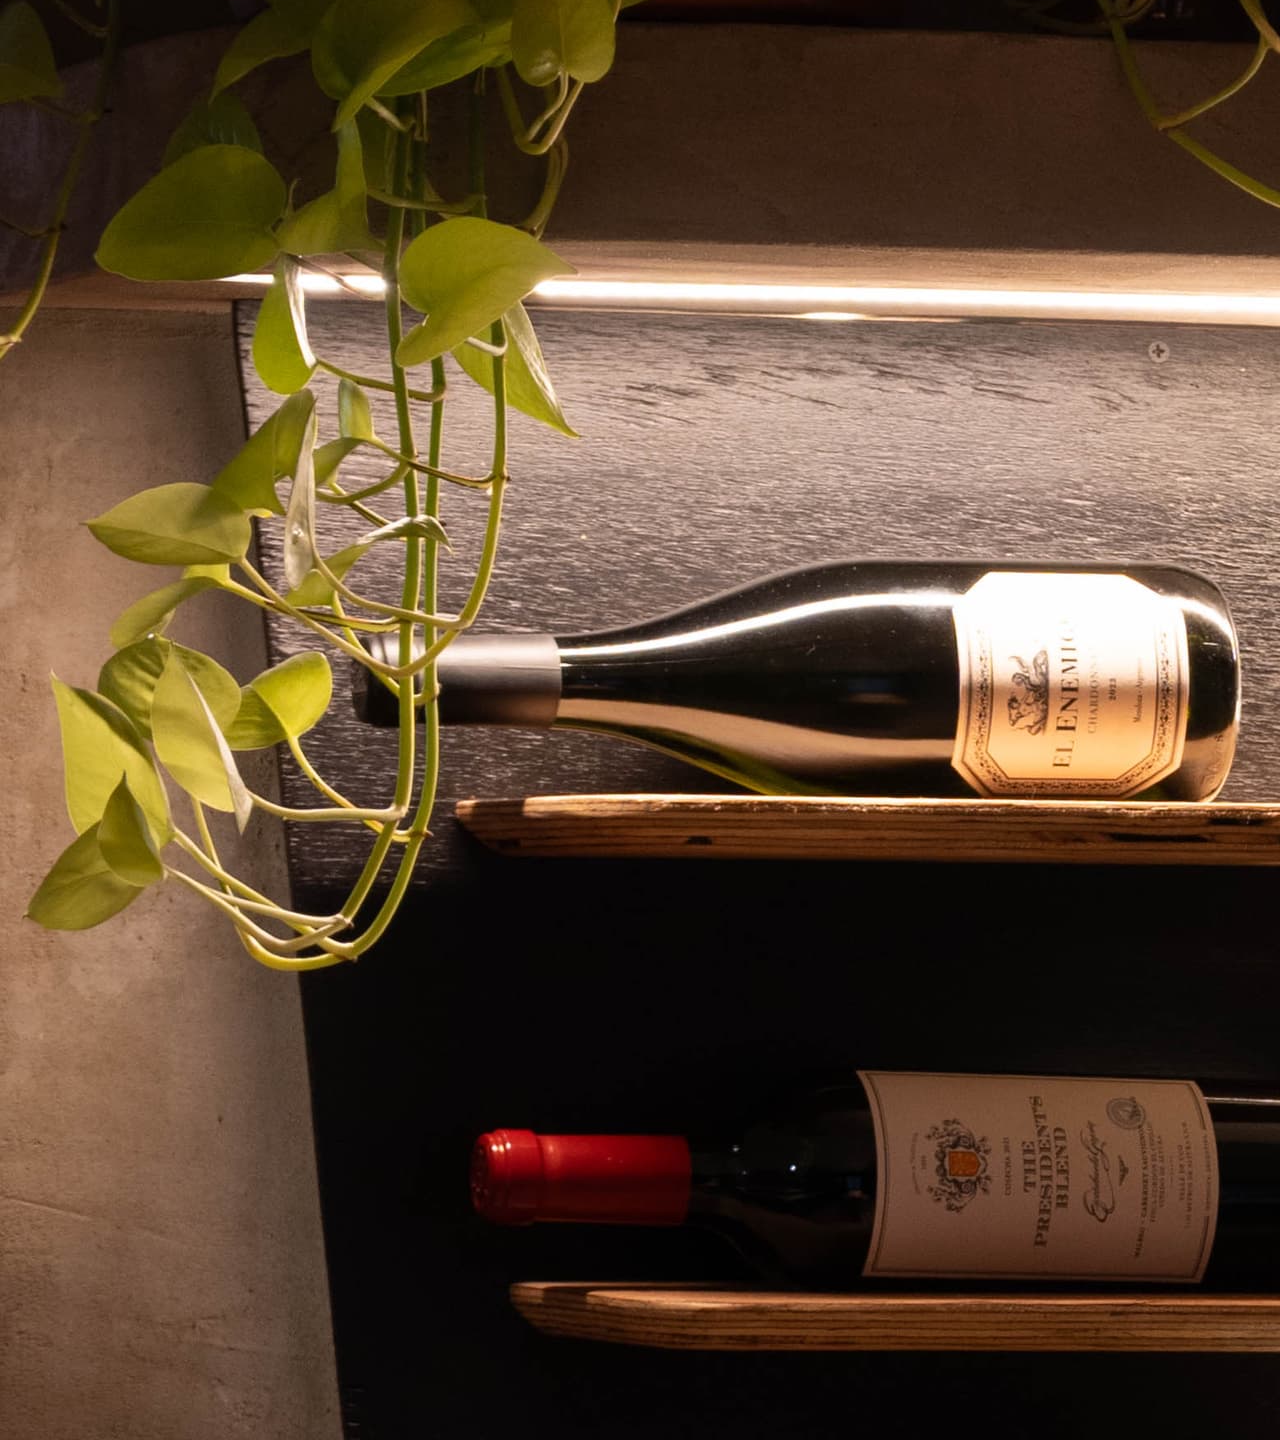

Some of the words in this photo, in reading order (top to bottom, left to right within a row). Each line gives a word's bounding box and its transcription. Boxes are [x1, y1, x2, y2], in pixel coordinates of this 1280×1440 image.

[1052, 740, 1075, 768] EL
[1022, 1140, 1037, 1192] THE
[1028, 1095, 1053, 1249] PRESIDENT'S
[1052, 1125, 1070, 1210] BLEND
